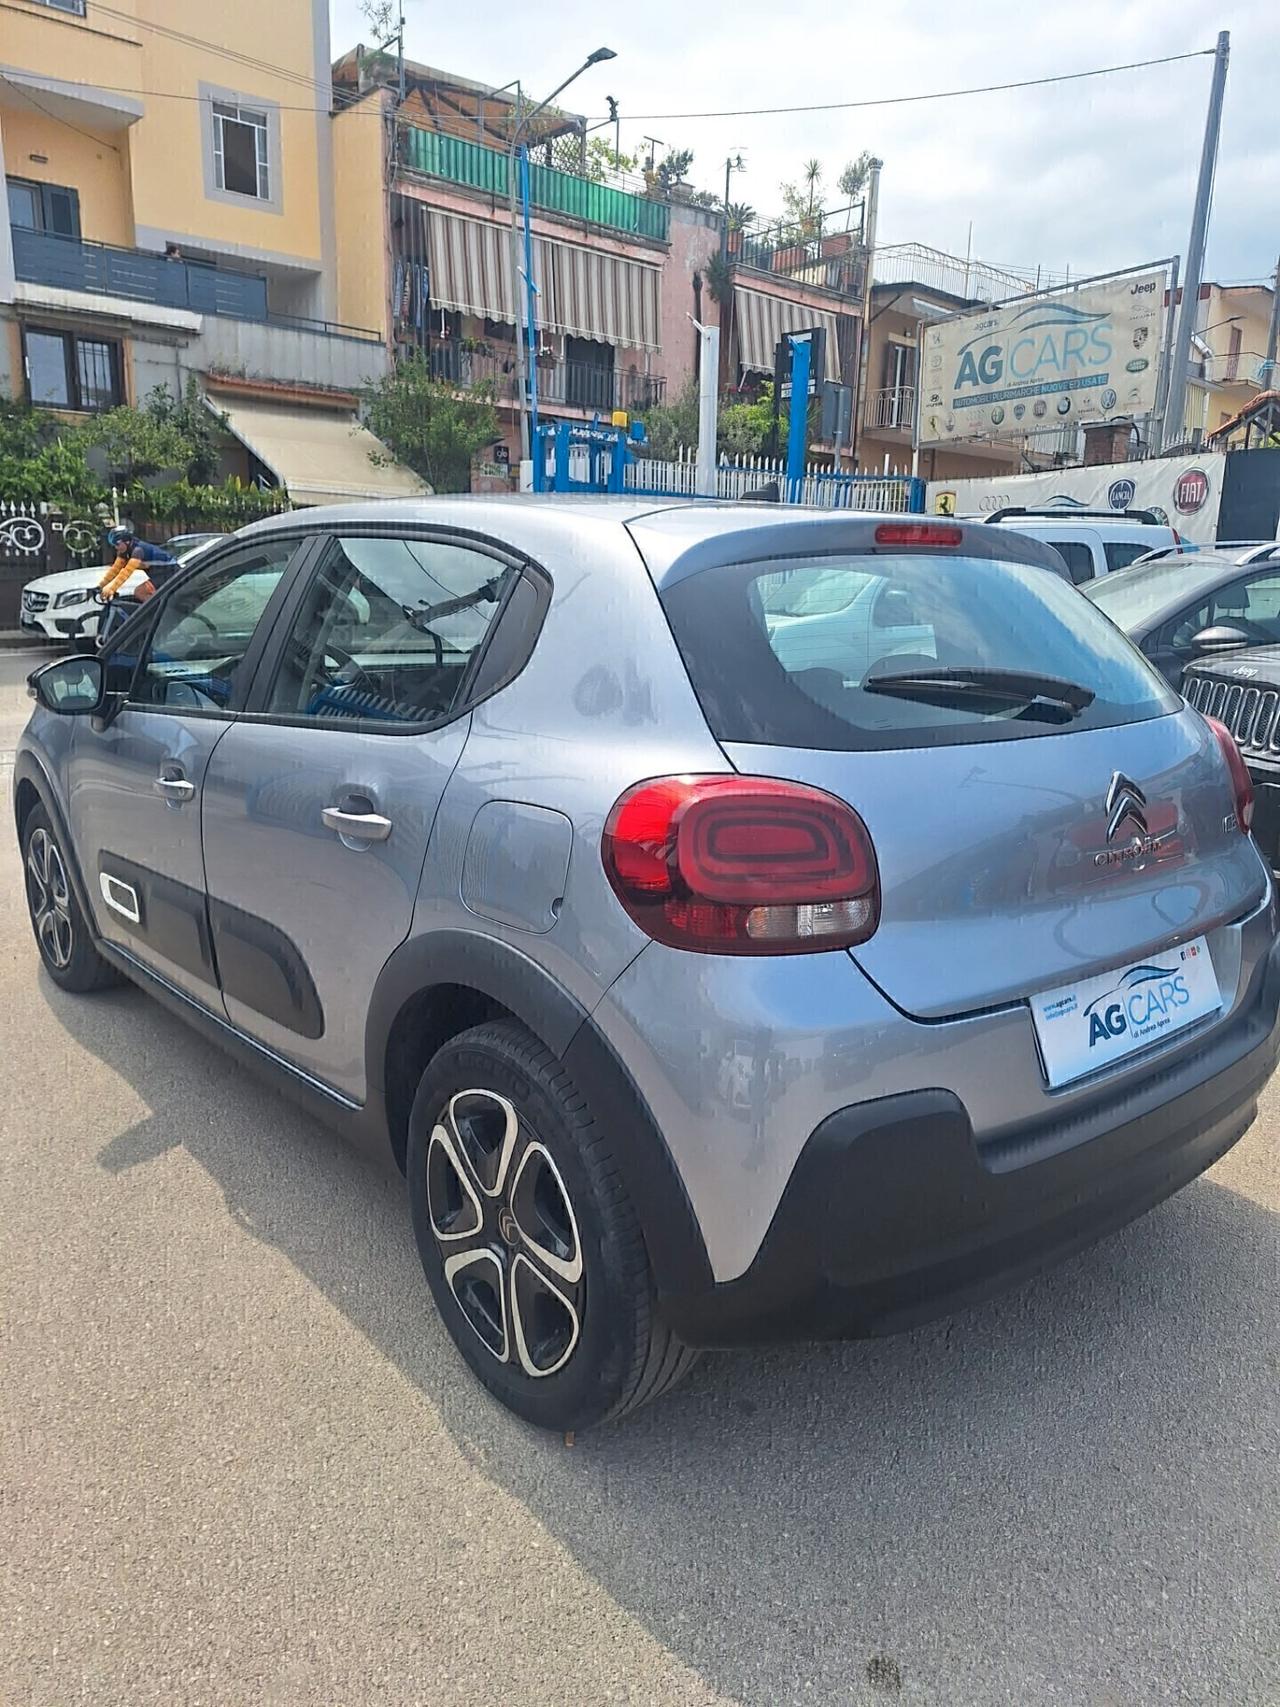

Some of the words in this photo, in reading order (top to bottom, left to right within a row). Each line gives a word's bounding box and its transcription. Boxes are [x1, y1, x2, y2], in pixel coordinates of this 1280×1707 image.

[1130, 282, 1156, 295] Jeep
[954, 345, 1003, 390] AG
[1010, 322, 1113, 378] CARS
[954, 395, 992, 406] AUTOMOBILI
[992, 387, 1040, 400] PLURIMARCHE
[1041, 382, 1069, 393] NUOVE
[1081, 374, 1108, 386] USATE
[1180, 481, 1202, 503] FIAT
[1232, 665, 1259, 678] Jeep
[1089, 1004, 1127, 1047] AG
[1128, 976, 1190, 1025] CARS
